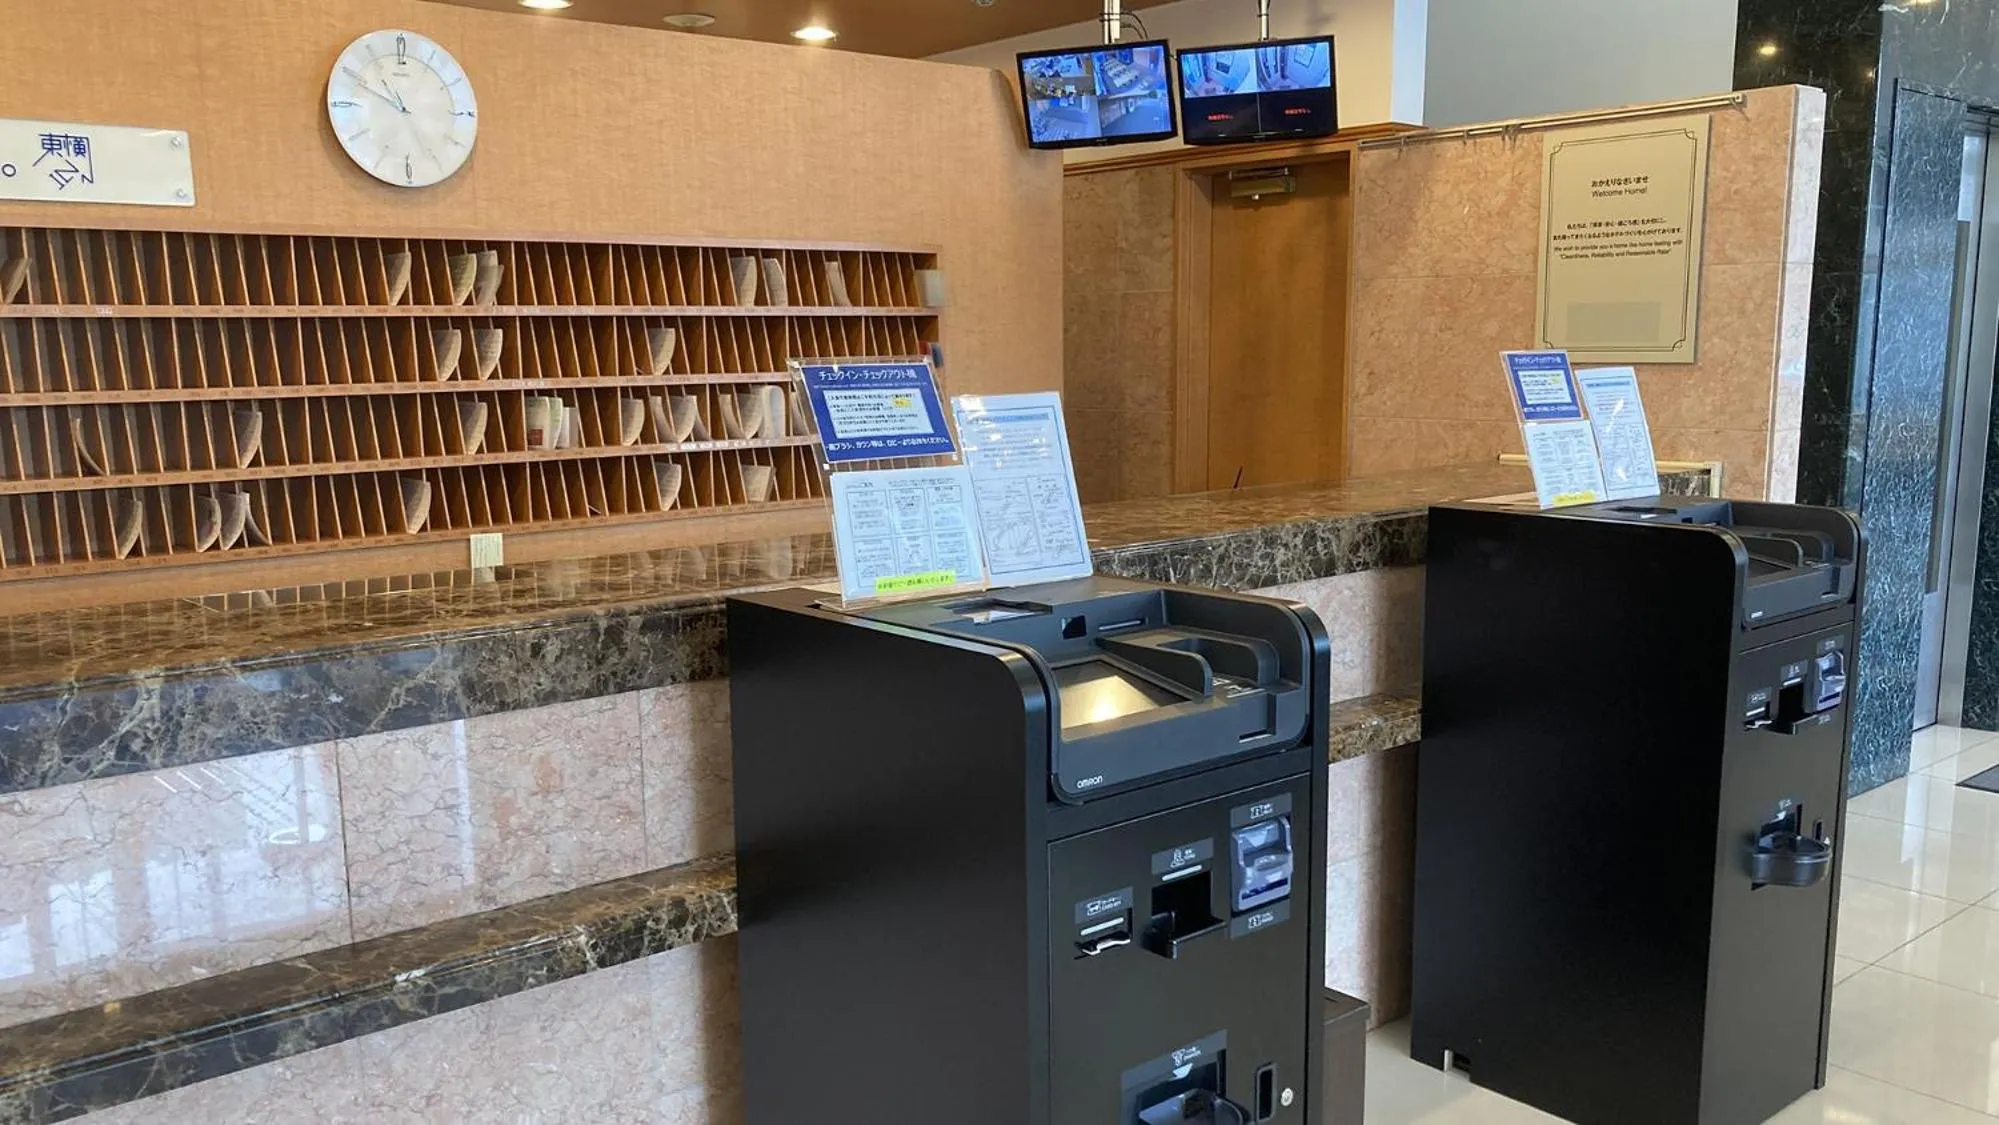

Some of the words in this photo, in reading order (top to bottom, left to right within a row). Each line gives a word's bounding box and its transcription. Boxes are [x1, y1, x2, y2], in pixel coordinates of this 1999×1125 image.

[1592, 175, 1648, 187] おかえりなさいませ
[1077, 775, 1103, 788] omron
